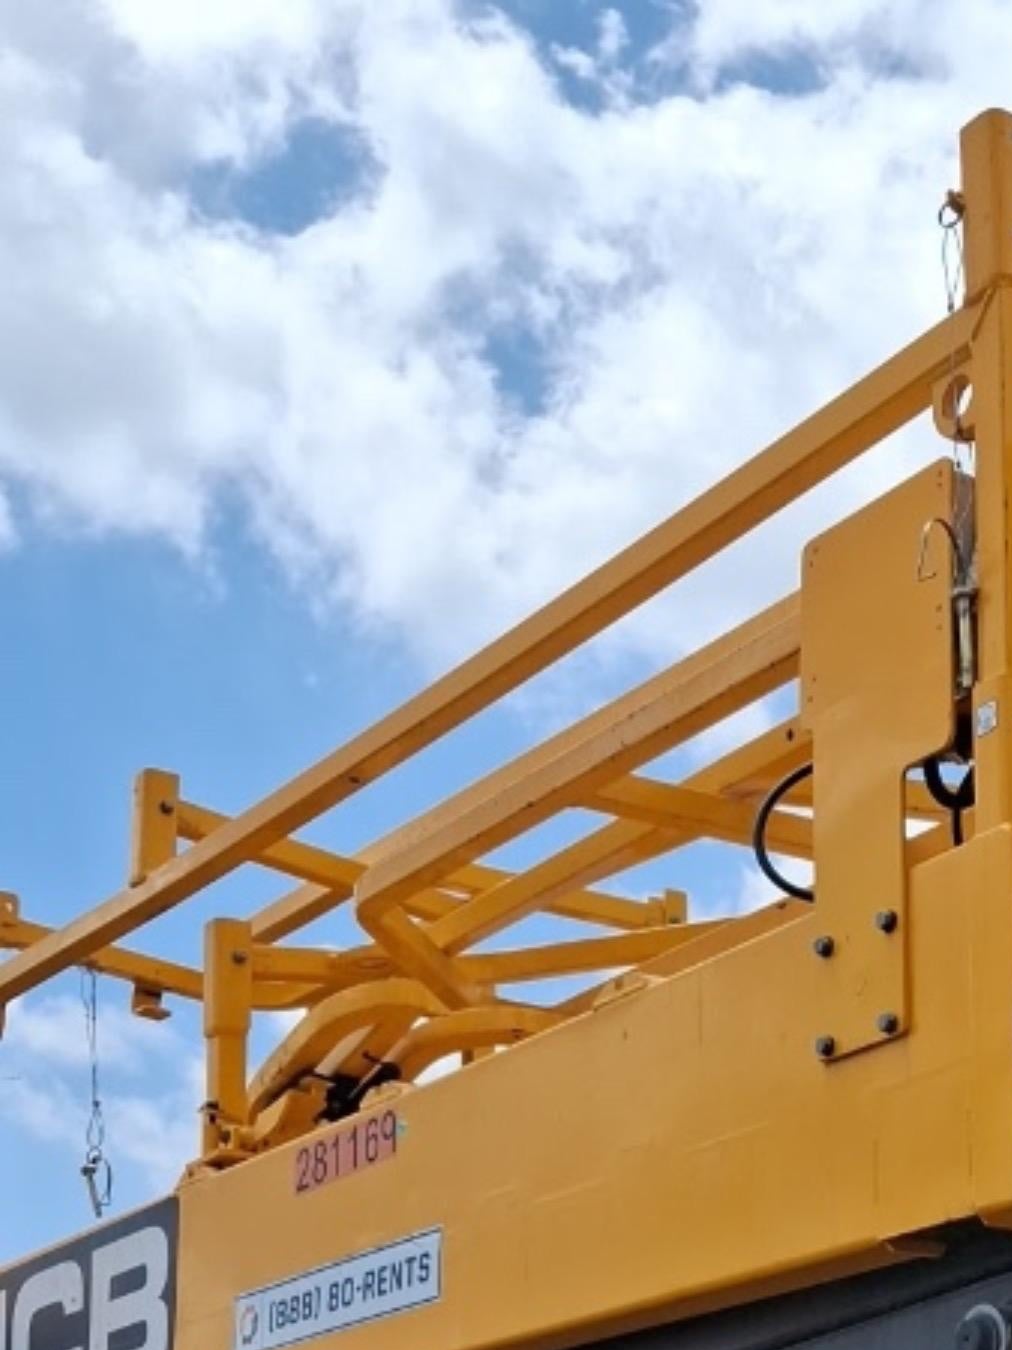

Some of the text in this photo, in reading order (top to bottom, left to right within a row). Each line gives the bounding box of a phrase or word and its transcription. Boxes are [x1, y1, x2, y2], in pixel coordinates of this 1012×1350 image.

[295, 1109, 398, 1194] 281169
[268, 1251, 432, 1334] (888) 80-RENTS
